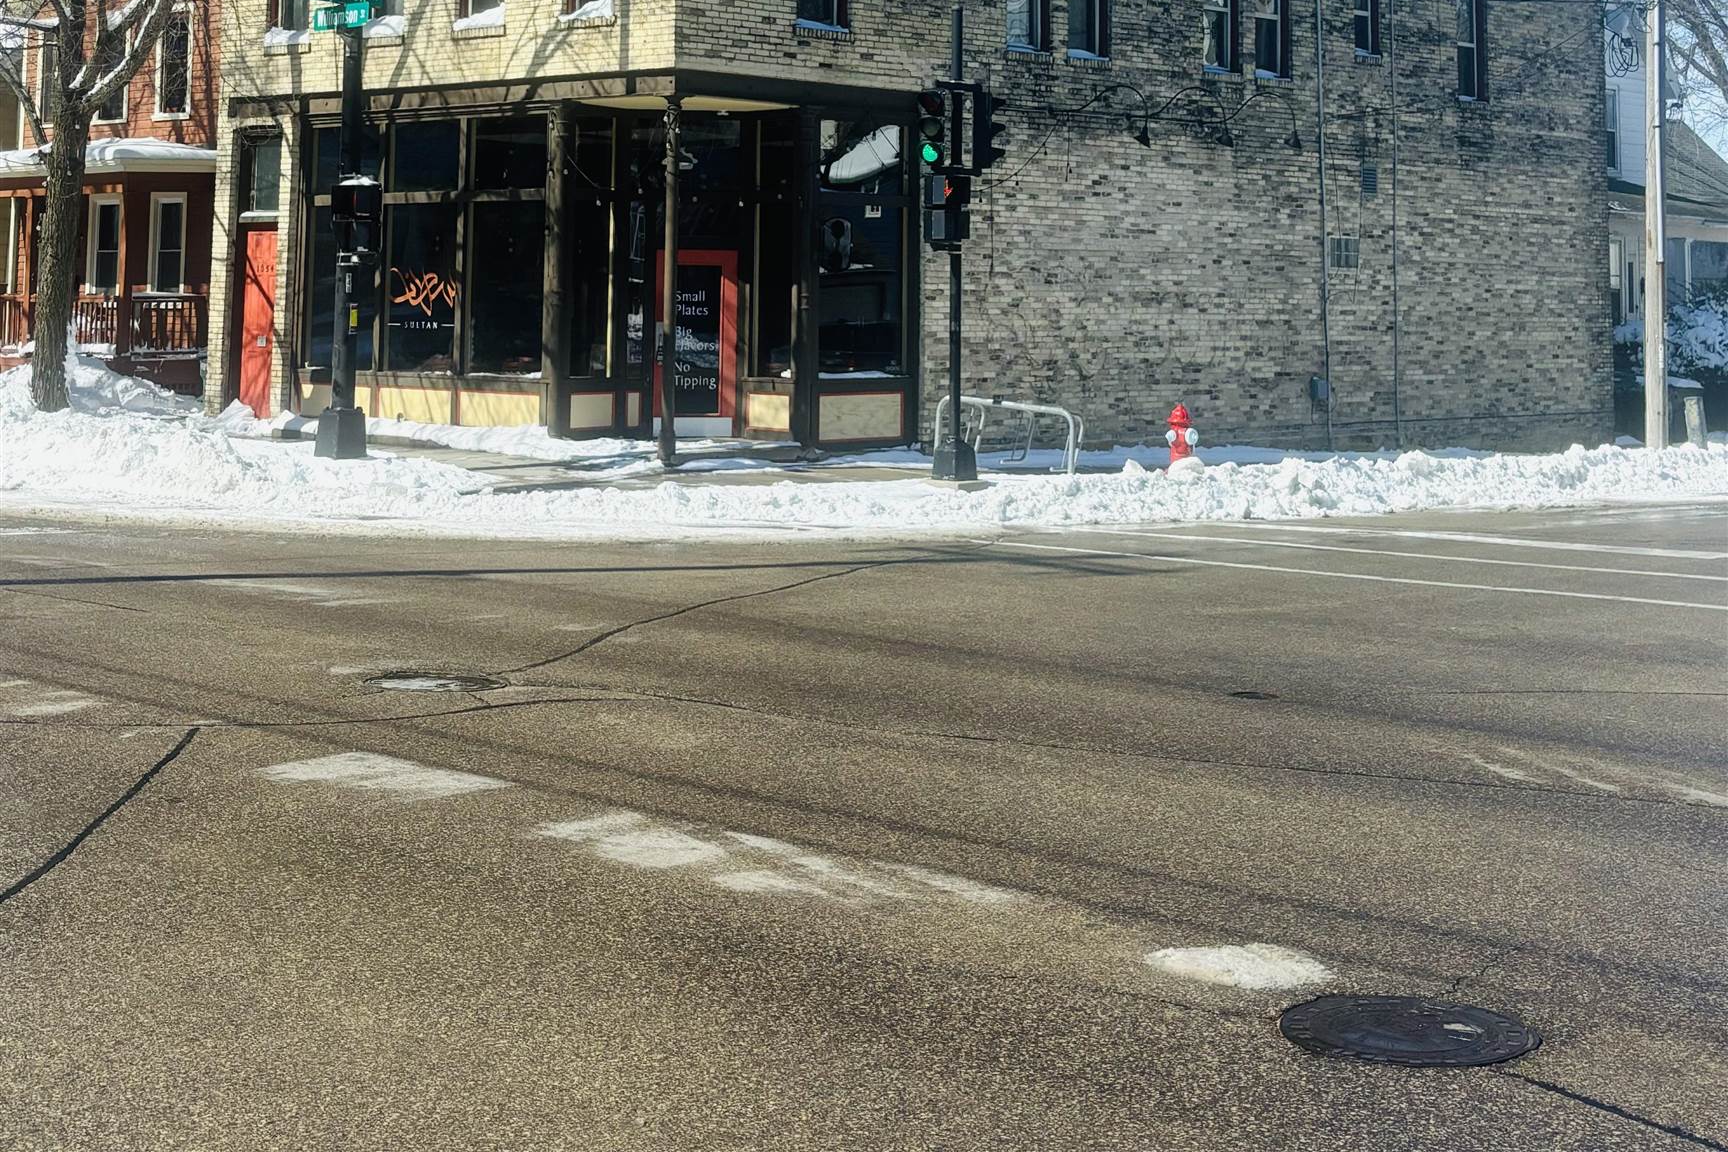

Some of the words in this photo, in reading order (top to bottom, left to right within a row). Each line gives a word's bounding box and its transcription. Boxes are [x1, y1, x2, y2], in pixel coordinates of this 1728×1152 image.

[317, 9, 359, 27] Williamson
[676, 290, 706, 302] Small
[404, 321, 438, 329] SULTAN
[675, 326, 692, 341] Big
[675, 375, 717, 390] Tipping
